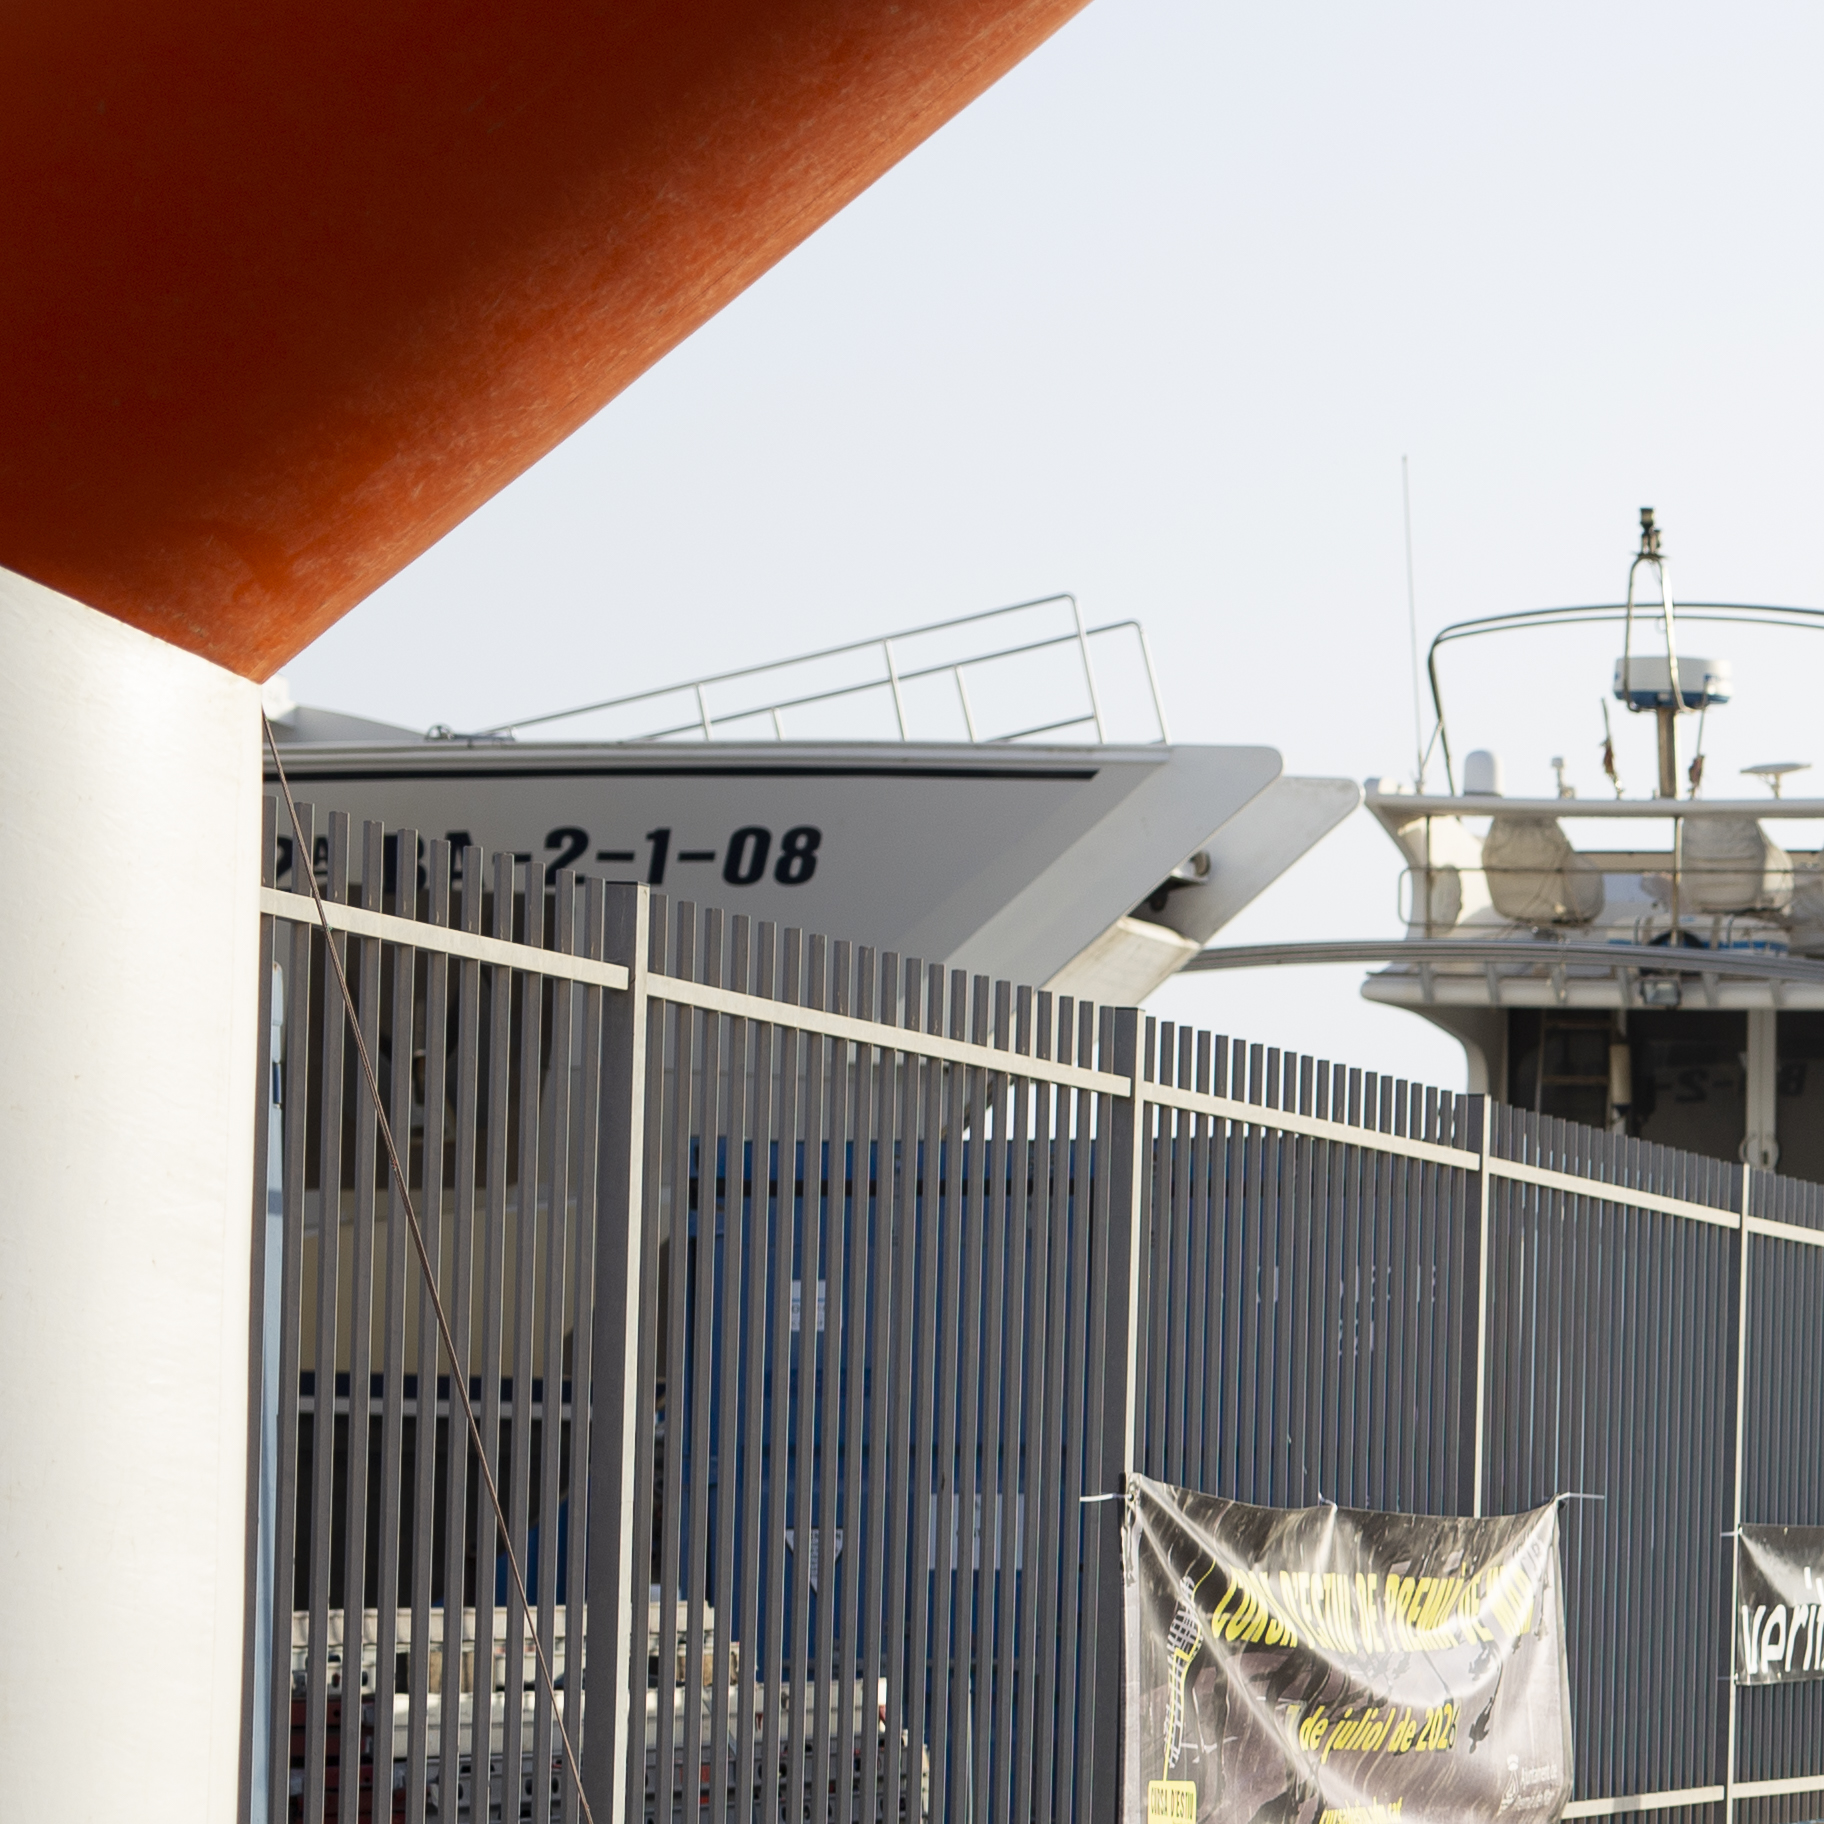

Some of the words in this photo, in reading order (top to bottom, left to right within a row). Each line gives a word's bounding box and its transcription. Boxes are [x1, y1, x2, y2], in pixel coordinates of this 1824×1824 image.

[1212, 1565, 1298, 1648] CURSA
[1355, 1573, 1386, 1654] DE
[1299, 1706, 1328, 1752] de
[1321, 1708, 1396, 1764] juliol
[1388, 1707, 1418, 1752] de
